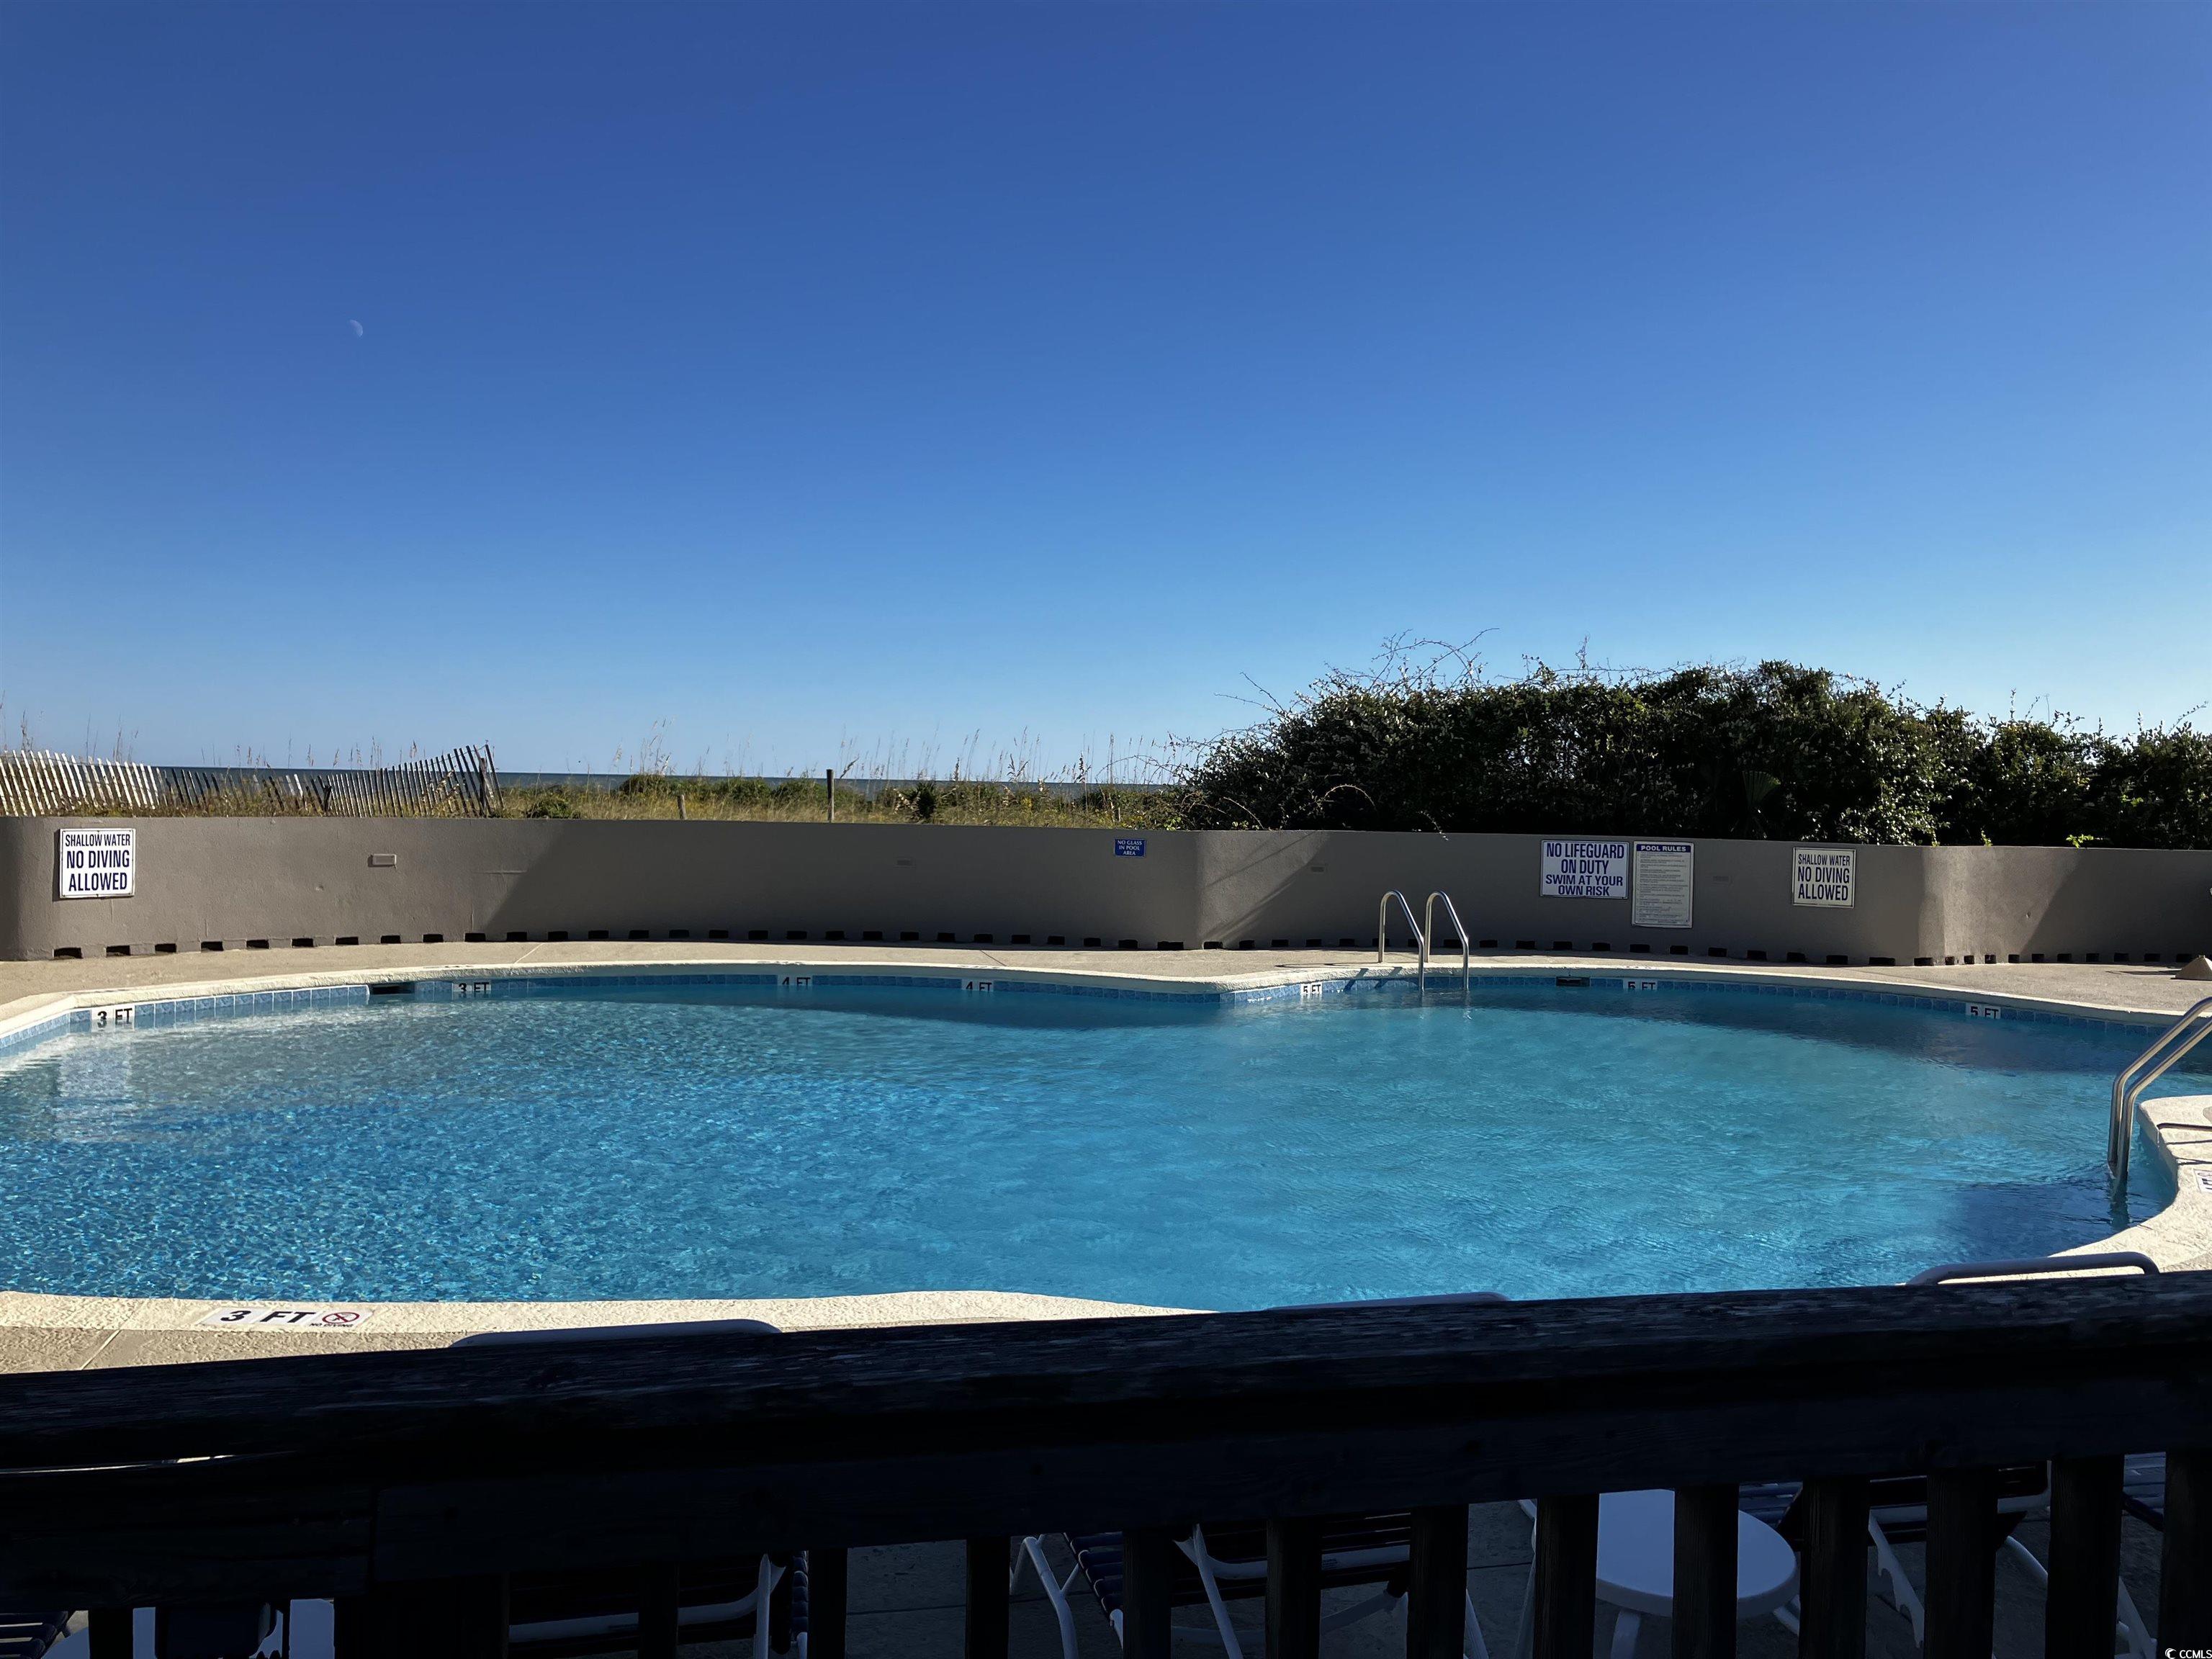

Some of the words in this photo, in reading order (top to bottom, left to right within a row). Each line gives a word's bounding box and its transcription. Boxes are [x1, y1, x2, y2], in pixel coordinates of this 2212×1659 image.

[65, 834, 102, 847] SHALLOW
[104, 834, 130, 846] WATER
[1547, 843, 1562, 857] NO
[1565, 843, 1624, 858] LIFEGUARD
[66, 850, 84, 868] NO
[89, 850, 130, 868] DIVING
[1798, 853, 1827, 866] SHALLOW
[1829, 855, 1851, 866] WATER
[1561, 859, 1576, 873] ON
[1579, 860, 1609, 874] DUTY
[68, 872, 127, 891] ALLOWED
[1546, 874, 1575, 884] SWIM
[1578, 875, 1592, 885] AT
[1595, 876, 1623, 886] YOUR
[1798, 866, 1812, 882] NO
[1815, 867, 1850, 884] DIVING
[1558, 885, 1583, 895] OWN
[1586, 886, 1610, 896] RISK
[1798, 884, 1848, 901] ALLOWED
[474, 982, 490, 992] FT
[796, 977, 811, 986] FT
[966, 981, 973, 989] 4
[979, 982, 992, 991] FT
[97, 1011, 107, 1028] 3
[115, 1008, 132, 1025] FT
[1970, 1006, 1978, 1016] 5
[1984, 1008, 1999, 1019] FT
[220, 1310, 251, 1321] 3
[260, 1311, 316, 1323] FT
